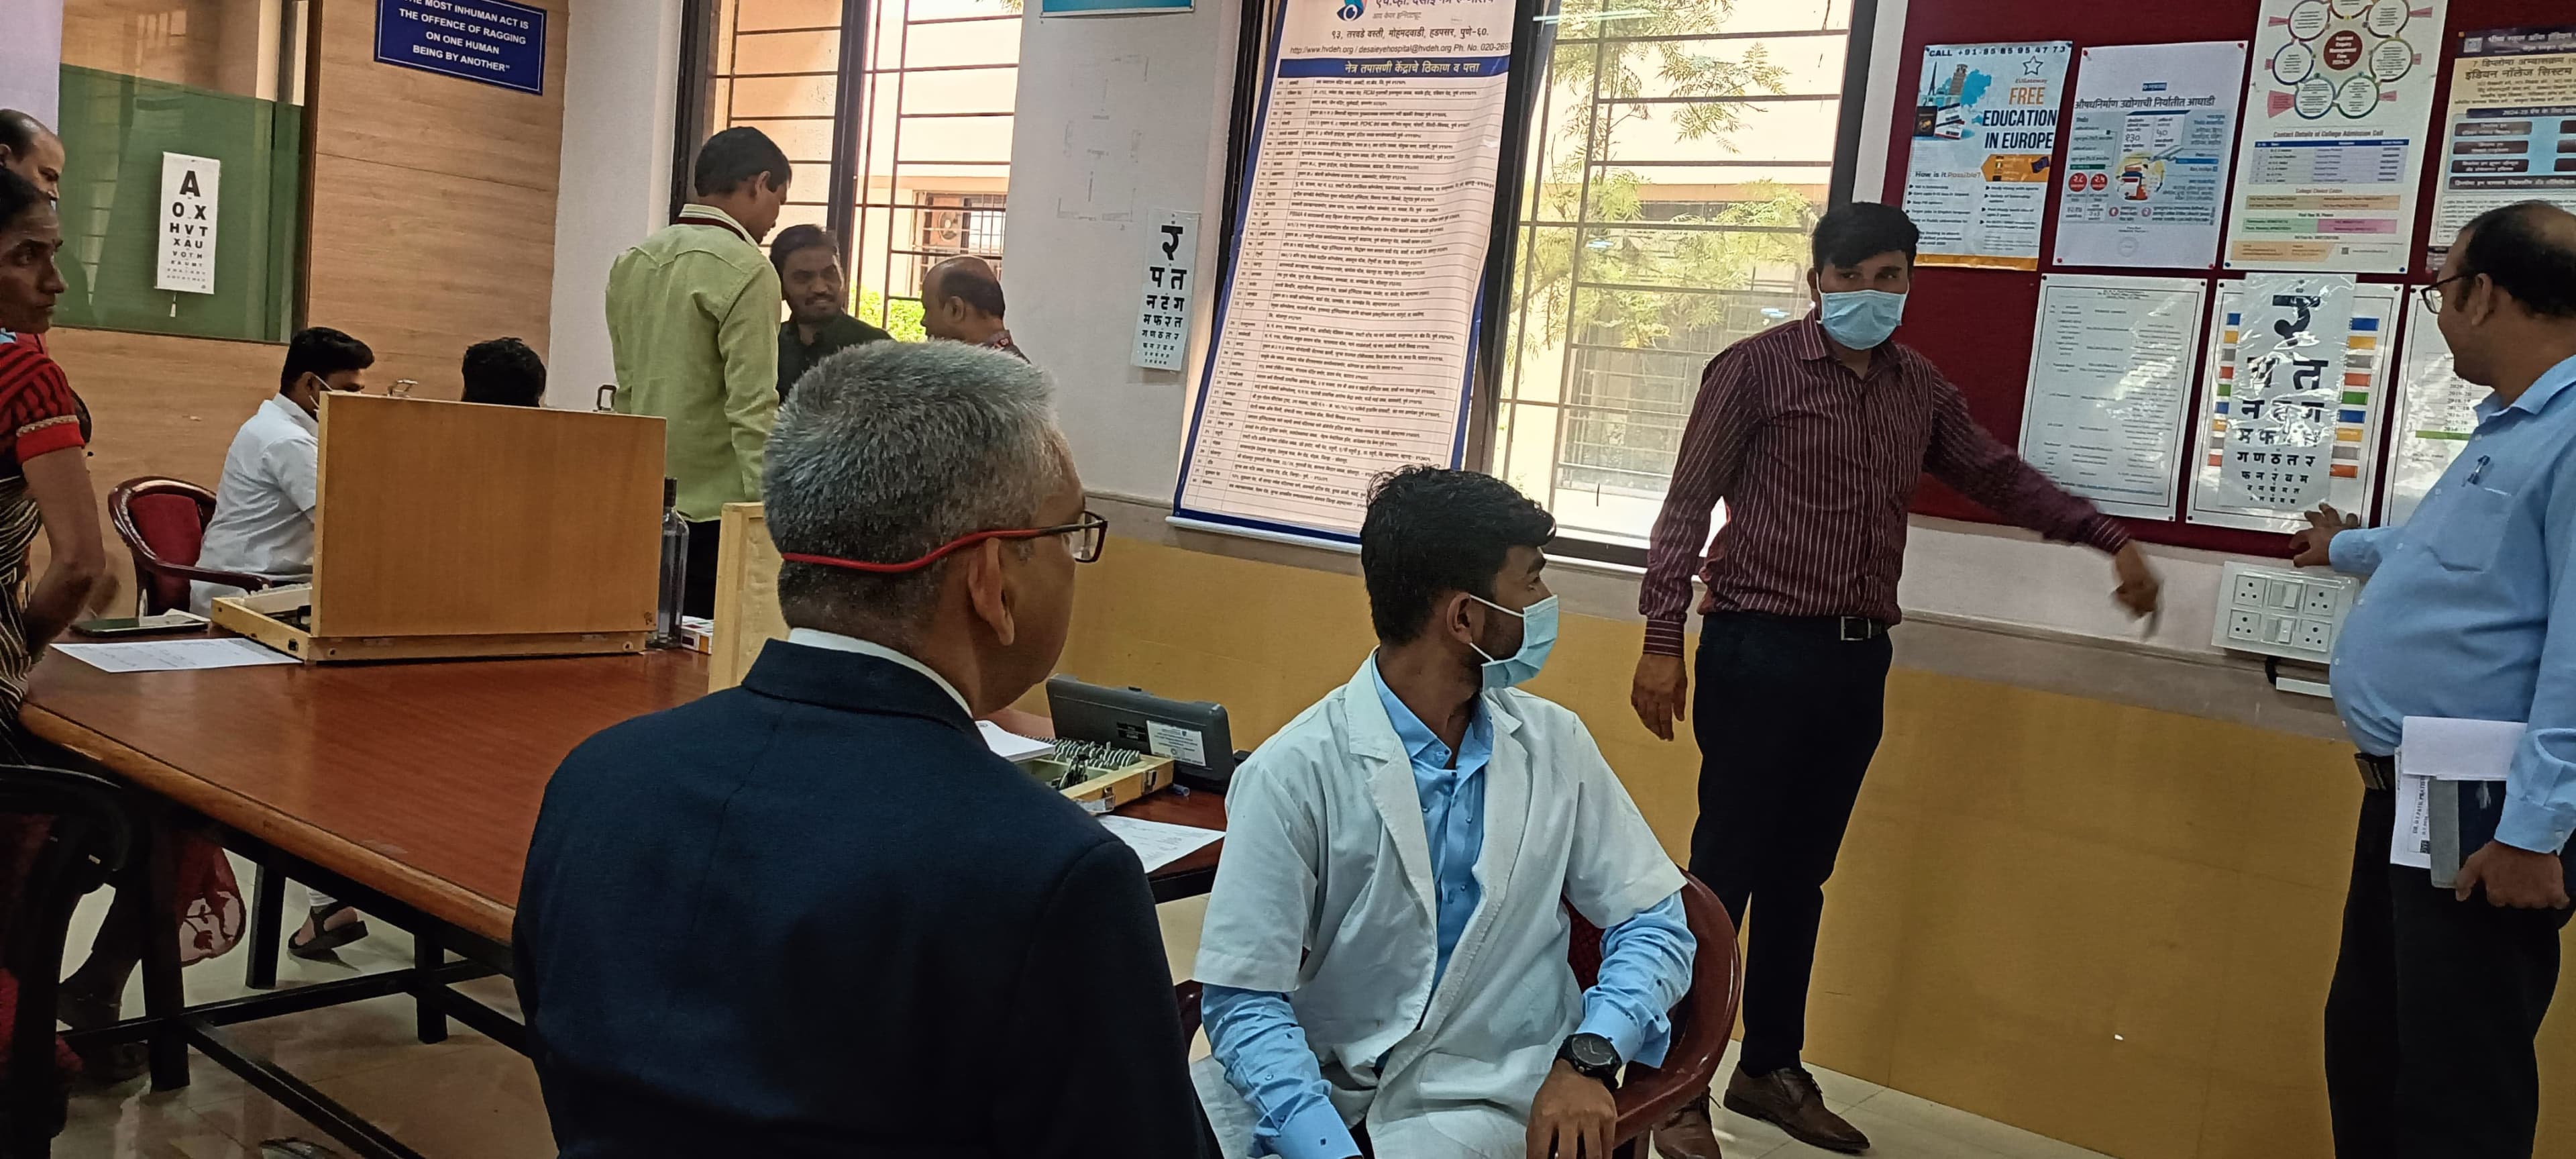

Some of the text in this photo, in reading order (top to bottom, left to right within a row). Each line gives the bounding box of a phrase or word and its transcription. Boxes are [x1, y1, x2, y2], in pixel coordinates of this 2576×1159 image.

[425, 0, 452, 11] MOST
[455, 5, 498, 22] INHUMAN
[499, 16, 518, 27] ACT
[520, 20, 529, 30] IS
[398, 8, 527, 45] THE OFFENCE OF RAGGING
[426, 32, 500, 54] ON ONE HUMAN
[413, 45, 443, 58] BEING
[445, 52, 459, 62] BY
[1344, 60, 1480, 74] नेत्र तपासणी केंद्राचे ठिकाण व पत्ता
[2009, 87, 2045, 105] FREE
[1982, 109, 2057, 127] EDUCATION
[1984, 132, 2054, 148] IN EUROPE
[179, 170, 201, 197] A
[172, 202, 207, 220] O X
[170, 223, 208, 236] H V T
[173, 238, 203, 249] X A U
[1161, 225, 1183, 260] र
[1150, 266, 1187, 291] प त
[1146, 295, 1185, 312] न ट ग
[1143, 314, 1183, 327] म फ र त
[2273, 295, 2320, 347] र
[2293, 360, 2328, 390] त
[2241, 400, 2265, 419] न
[2237, 452, 2316, 467] ग ण ठ त र
